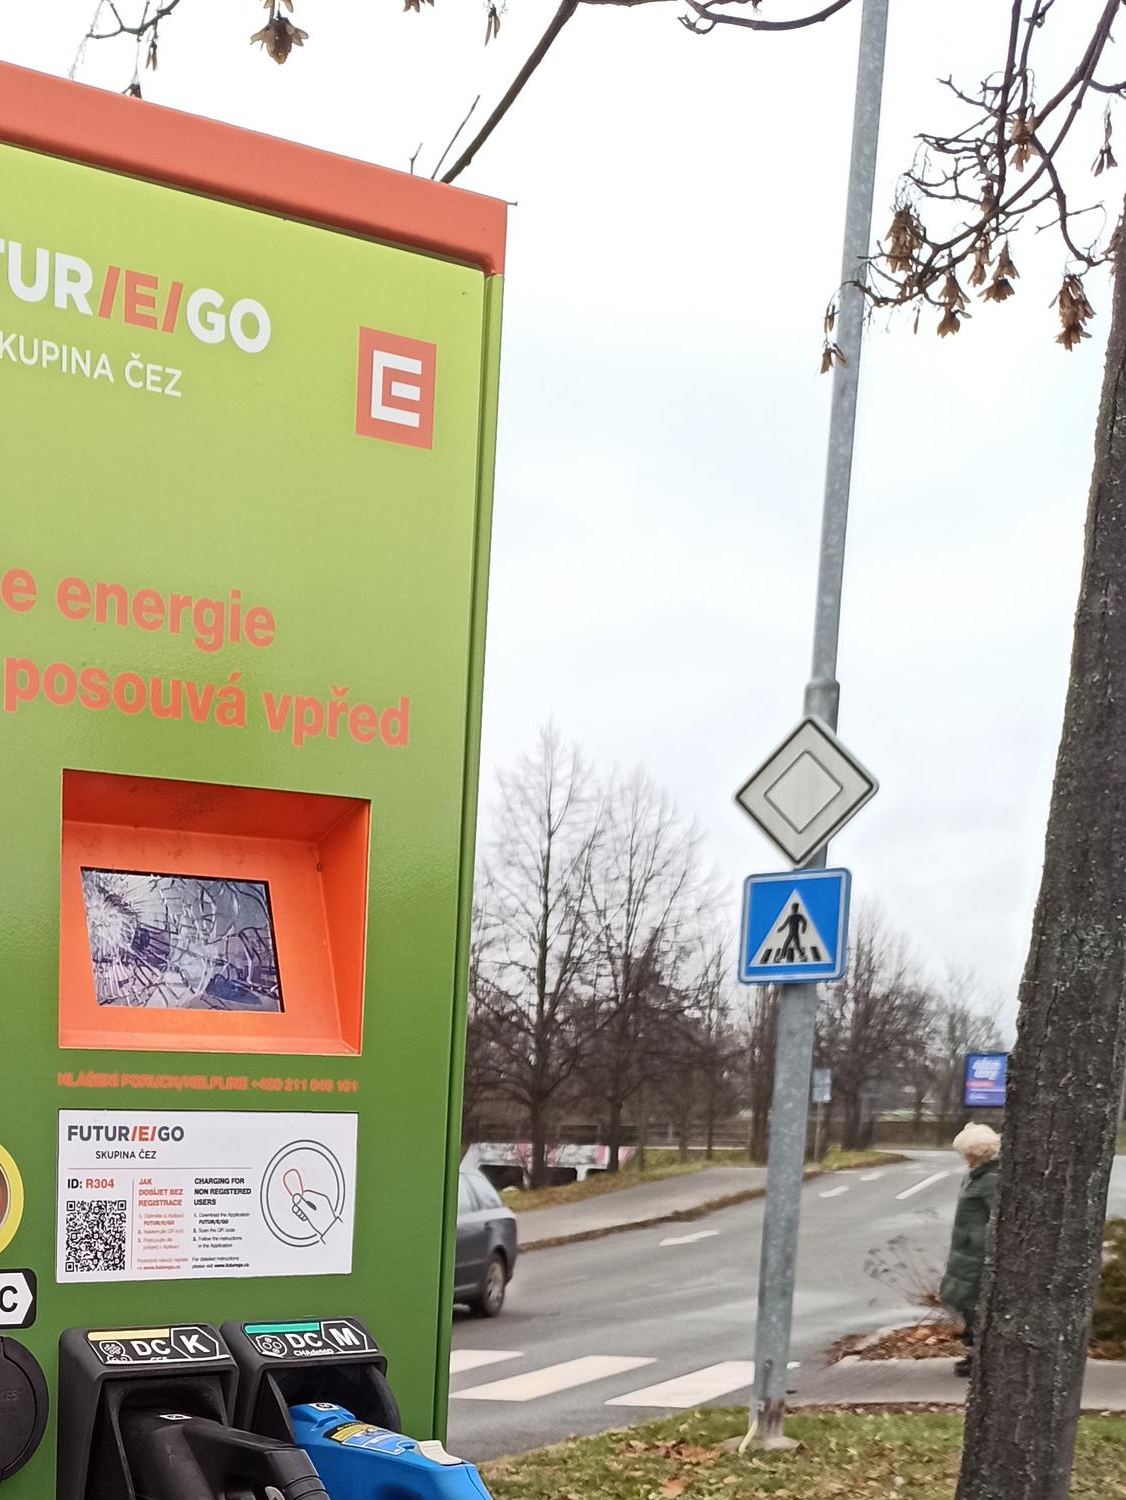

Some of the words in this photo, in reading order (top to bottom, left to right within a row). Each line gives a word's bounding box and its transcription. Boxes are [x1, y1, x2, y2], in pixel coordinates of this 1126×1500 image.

[124, 352, 183, 397] ČEZ
[56, 575, 276, 652] energie
[4, 656, 247, 728] posouvá
[263, 686, 411, 747] vpřed
[67, 1125, 185, 1142] FUTUR/E/GO
[95, 1151, 136, 1159] SKUPINA
[138, 1149, 157, 1159] ČEZ
[67, 1179, 83, 1189] ID:
[85, 1178, 115, 1189] R304
[194, 1177, 230, 1185] CHARGING
[231, 1177, 245, 1185] FOR
[138, 1199, 182, 1207] REGISTRACE
[179, 1334, 211, 1354] K
[285, 1333, 323, 1349] DC
[329, 1327, 360, 1346] M
[130, 1340, 171, 1356] DC
